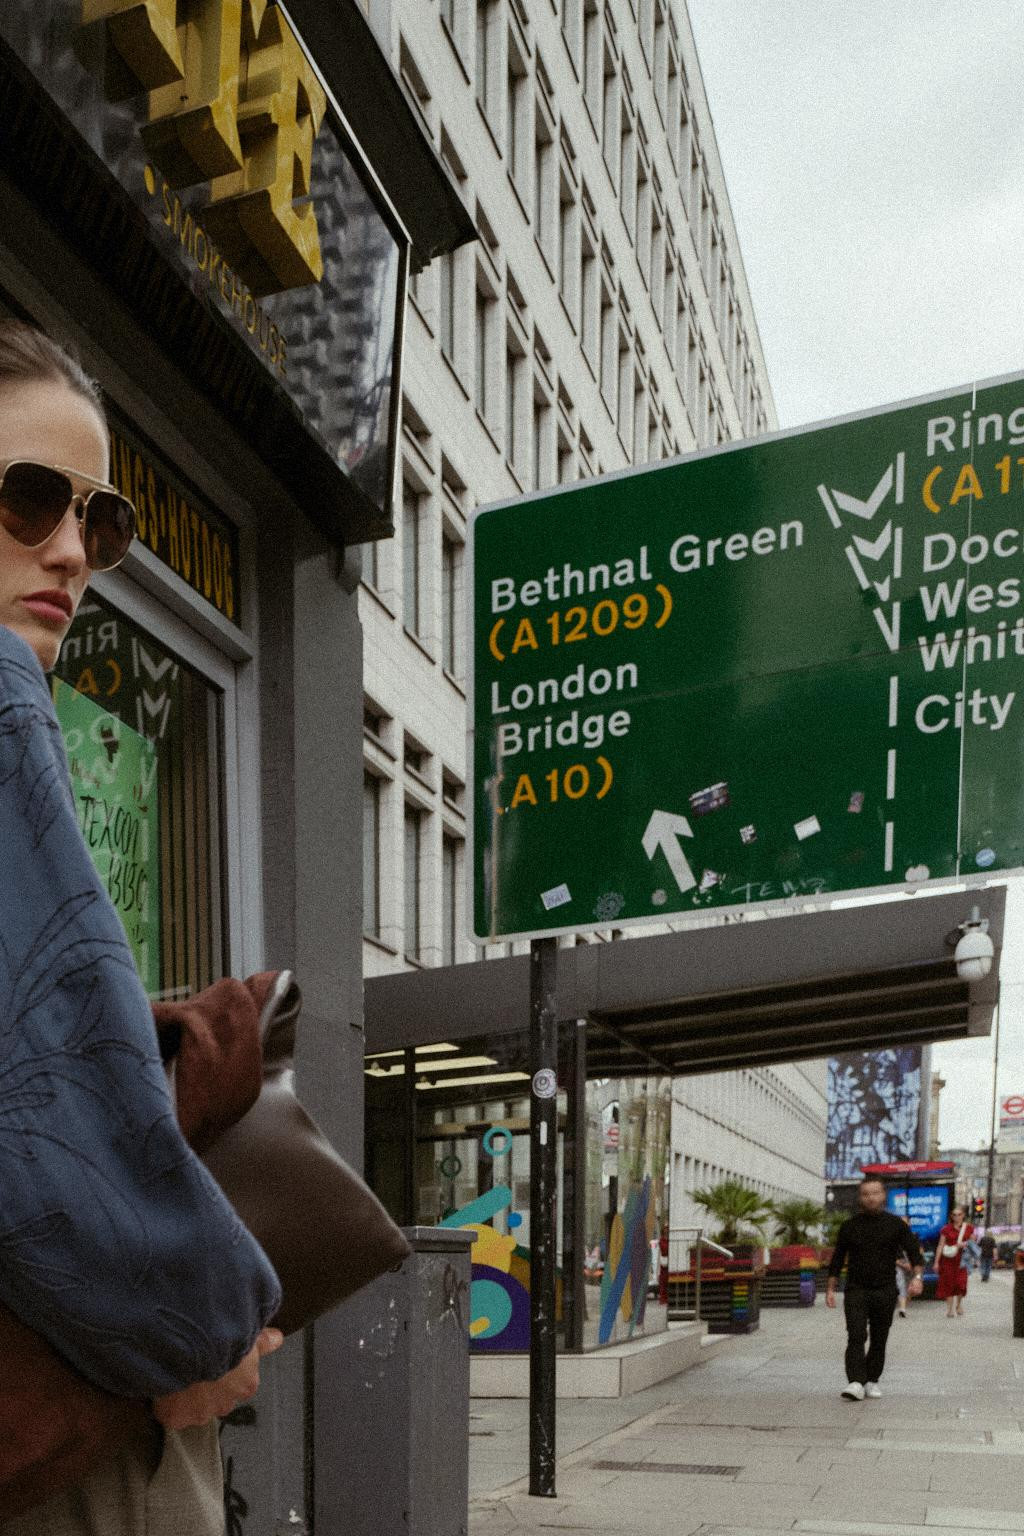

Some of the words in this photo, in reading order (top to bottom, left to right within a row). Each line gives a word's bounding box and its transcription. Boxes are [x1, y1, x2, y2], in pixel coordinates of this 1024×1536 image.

[162, 182, 288, 376] SMOKEHOUSE
[922, 454, 1024, 513] (A1
[491, 545, 653, 614] Bethnal
[669, 520, 804, 573] Green
[923, 528, 1024, 573] Doc
[491, 662, 638, 715] London
[915, 688, 1016, 734] City
[498, 710, 631, 757] Bridge
[495, 756, 613, 815] A10)
